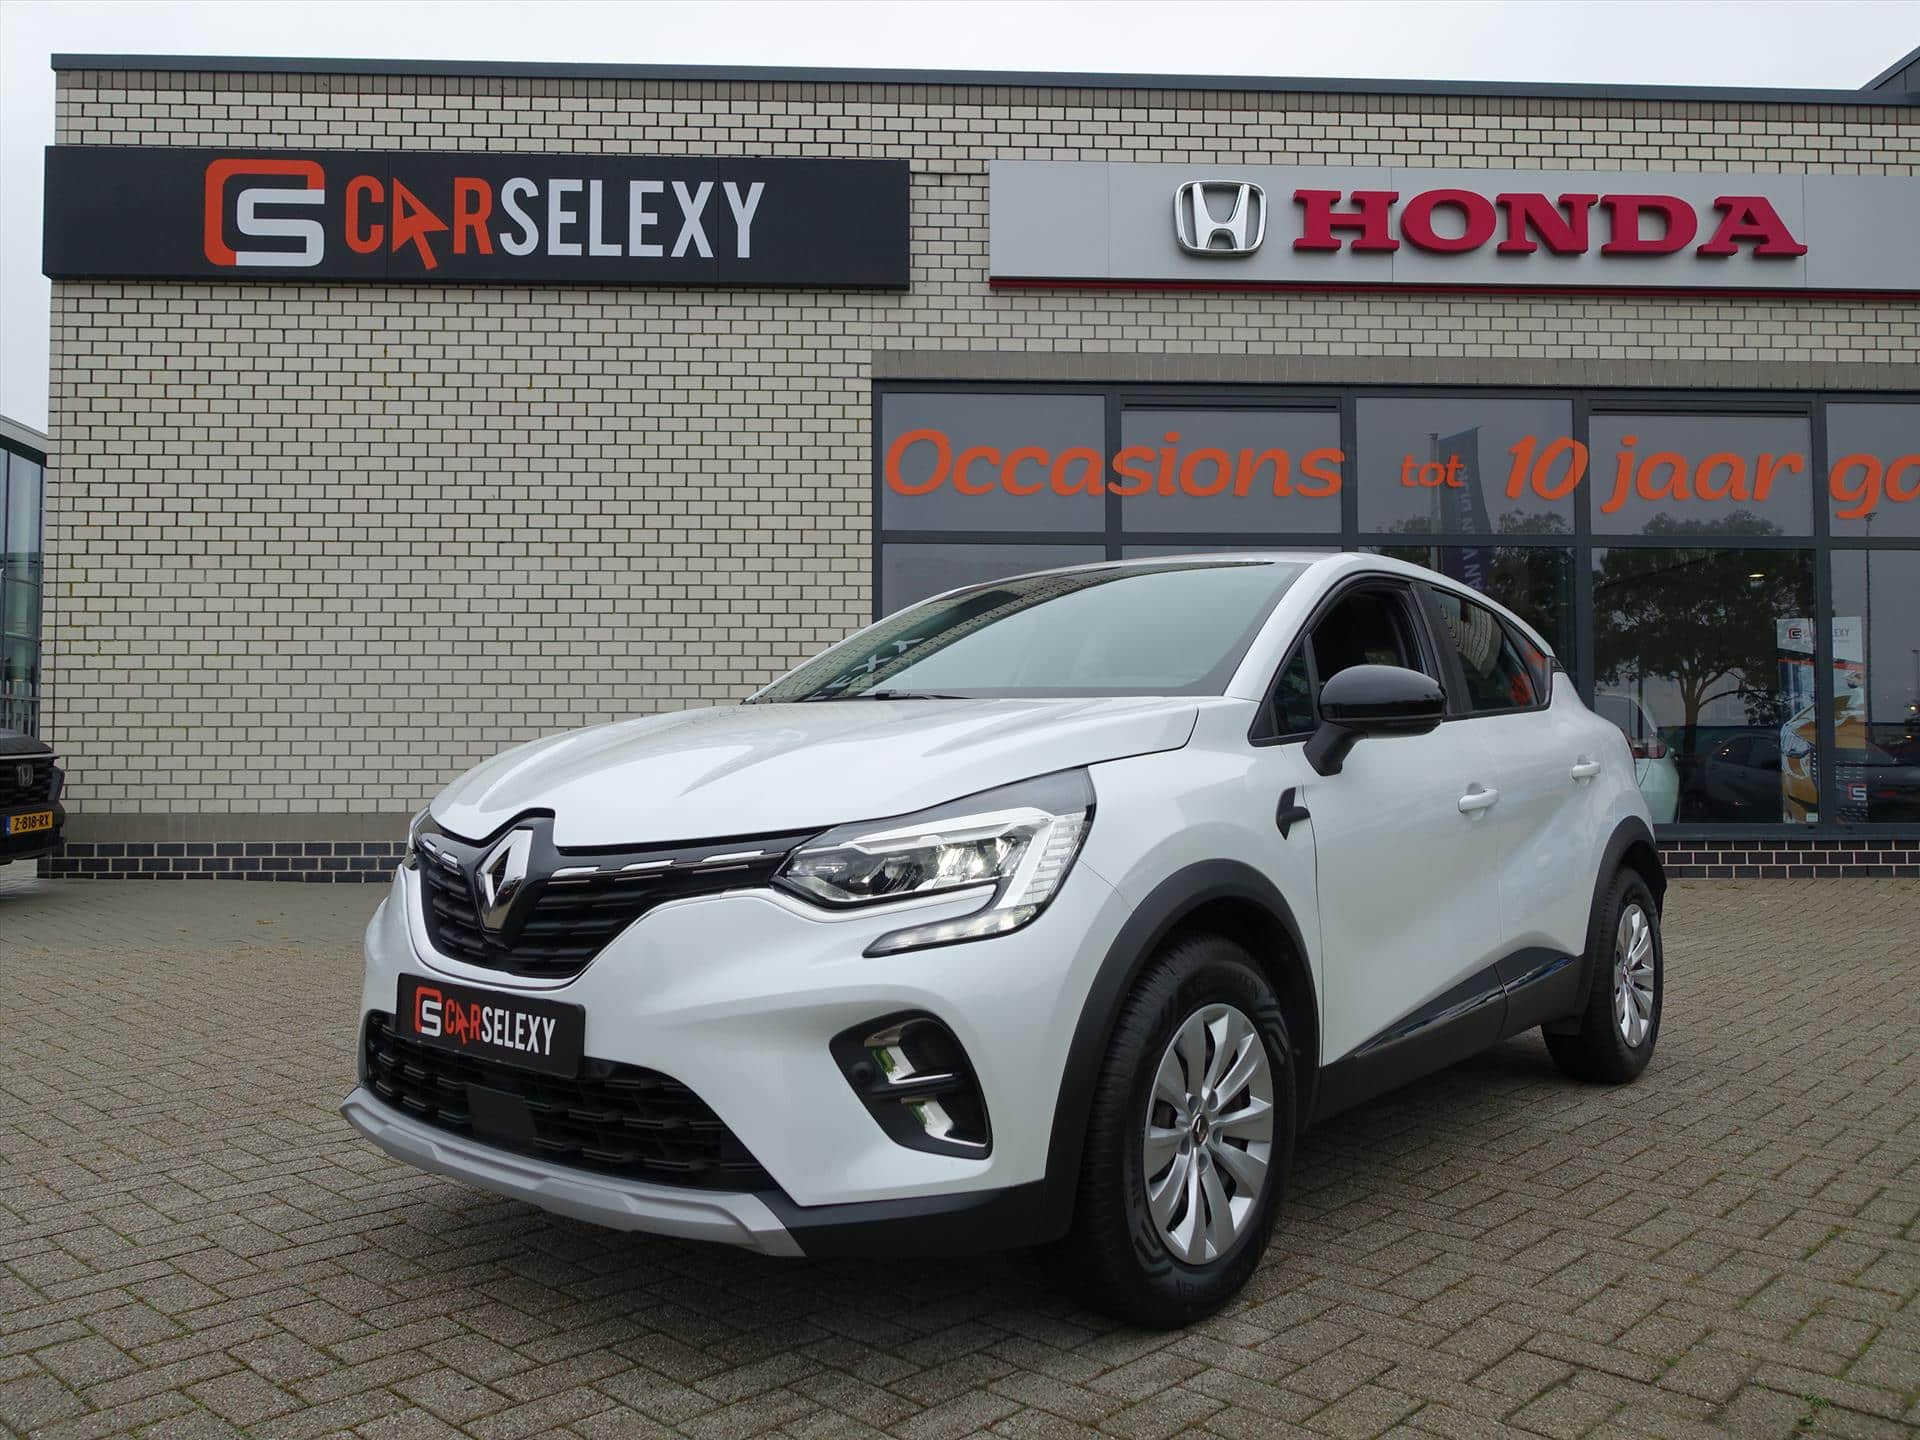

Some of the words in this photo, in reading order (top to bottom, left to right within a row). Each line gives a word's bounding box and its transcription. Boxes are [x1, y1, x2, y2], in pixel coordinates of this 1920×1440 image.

[346, 175, 765, 270] CARSELEXY
[1293, 188, 1807, 257] HONDA
[885, 429, 1345, 497] Occasions
[1401, 453, 1464, 487] tot
[1505, 435, 1589, 500] 10
[1601, 435, 1805, 515] jaar
[444, 998, 556, 1056] CARSELEXY
